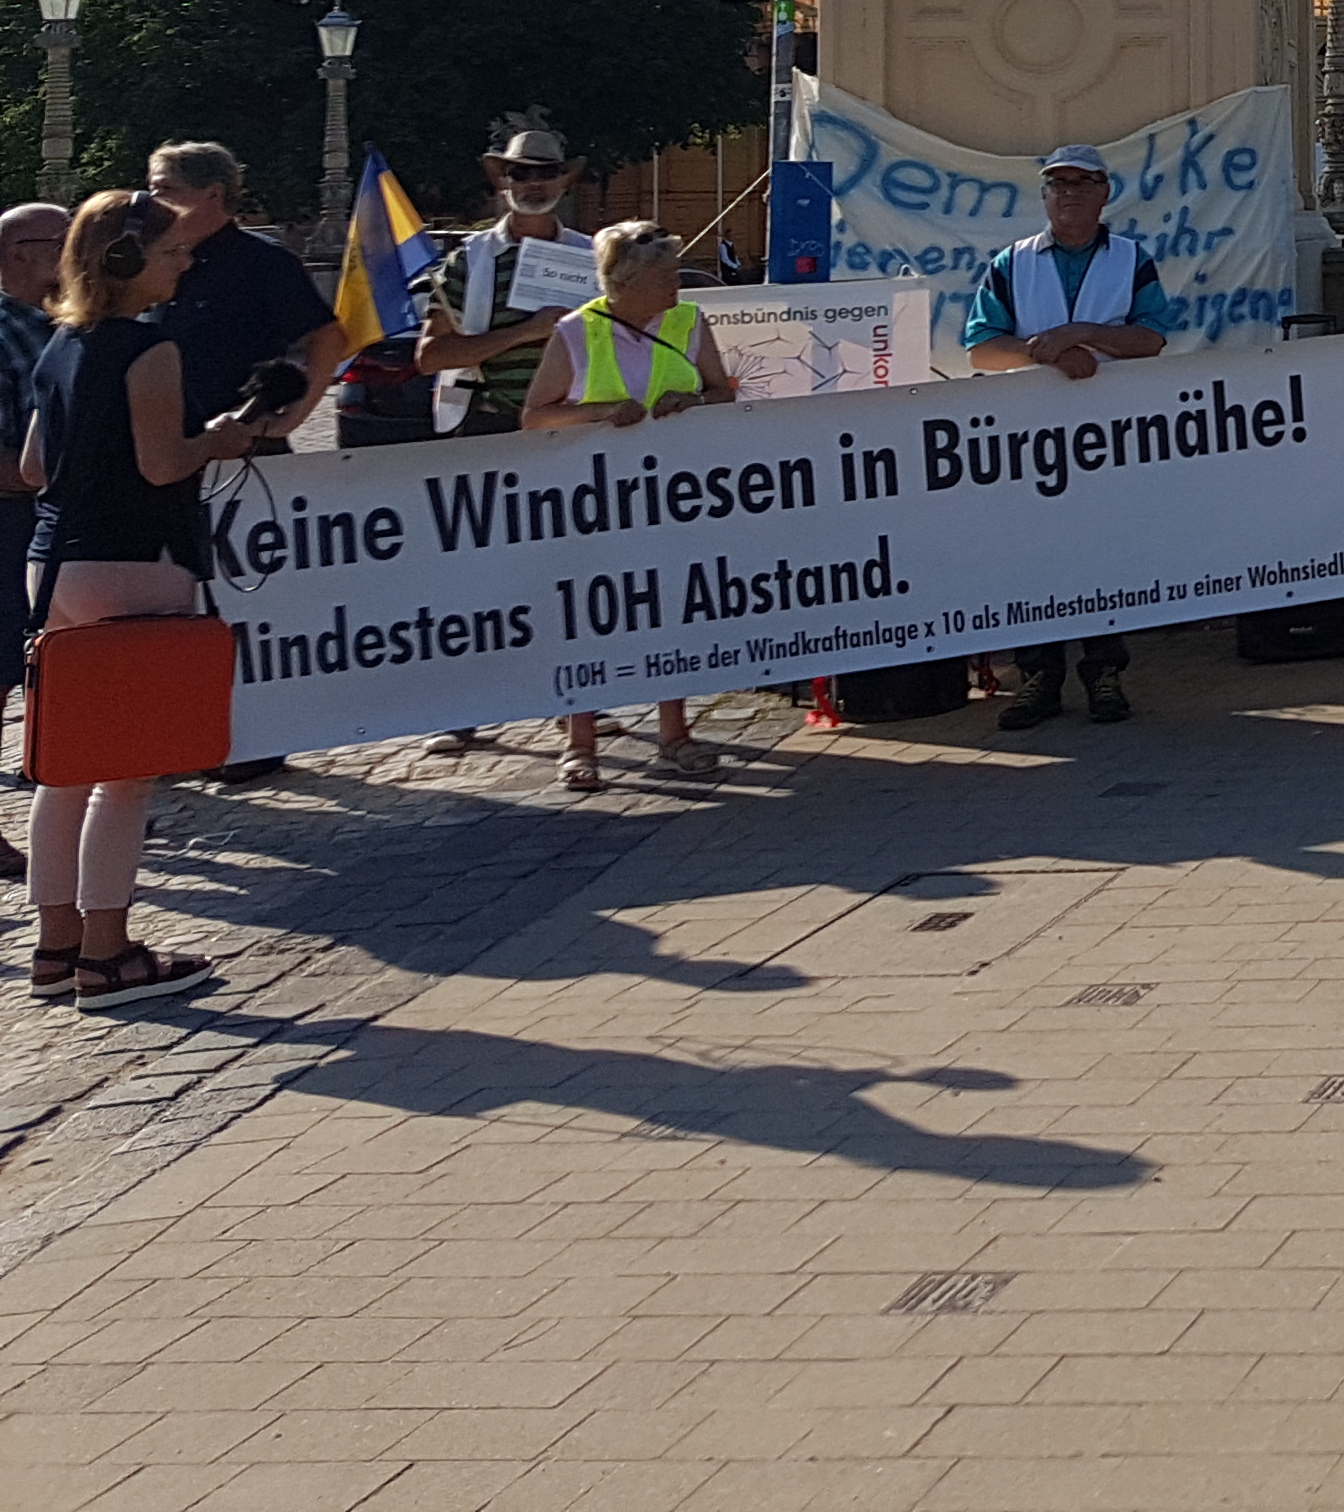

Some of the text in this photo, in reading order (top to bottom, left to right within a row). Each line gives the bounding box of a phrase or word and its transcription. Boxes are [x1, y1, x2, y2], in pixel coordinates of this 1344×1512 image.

[811, 109, 1020, 217] Dem
[1155, 206, 1236, 262] ihr
[824, 303, 889, 324] gegen
[199, 375, 1308, 582] Keine Windriesen in Bürgernähe!
[554, 659, 607, 696] (10H
[645, 648, 701, 678] Höhe
[708, 643, 741, 670] der
[745, 619, 919, 664] Windkraftanlage
[924, 620, 935, 638] x
[942, 610, 965, 636] 10
[972, 603, 1000, 630] als
[1006, 579, 1161, 628] Mindestabstand
[1166, 583, 1188, 602] zu
[1194, 573, 1242, 598] einer
[557, 568, 662, 641] 10H
[682, 535, 910, 624] Abstand.
